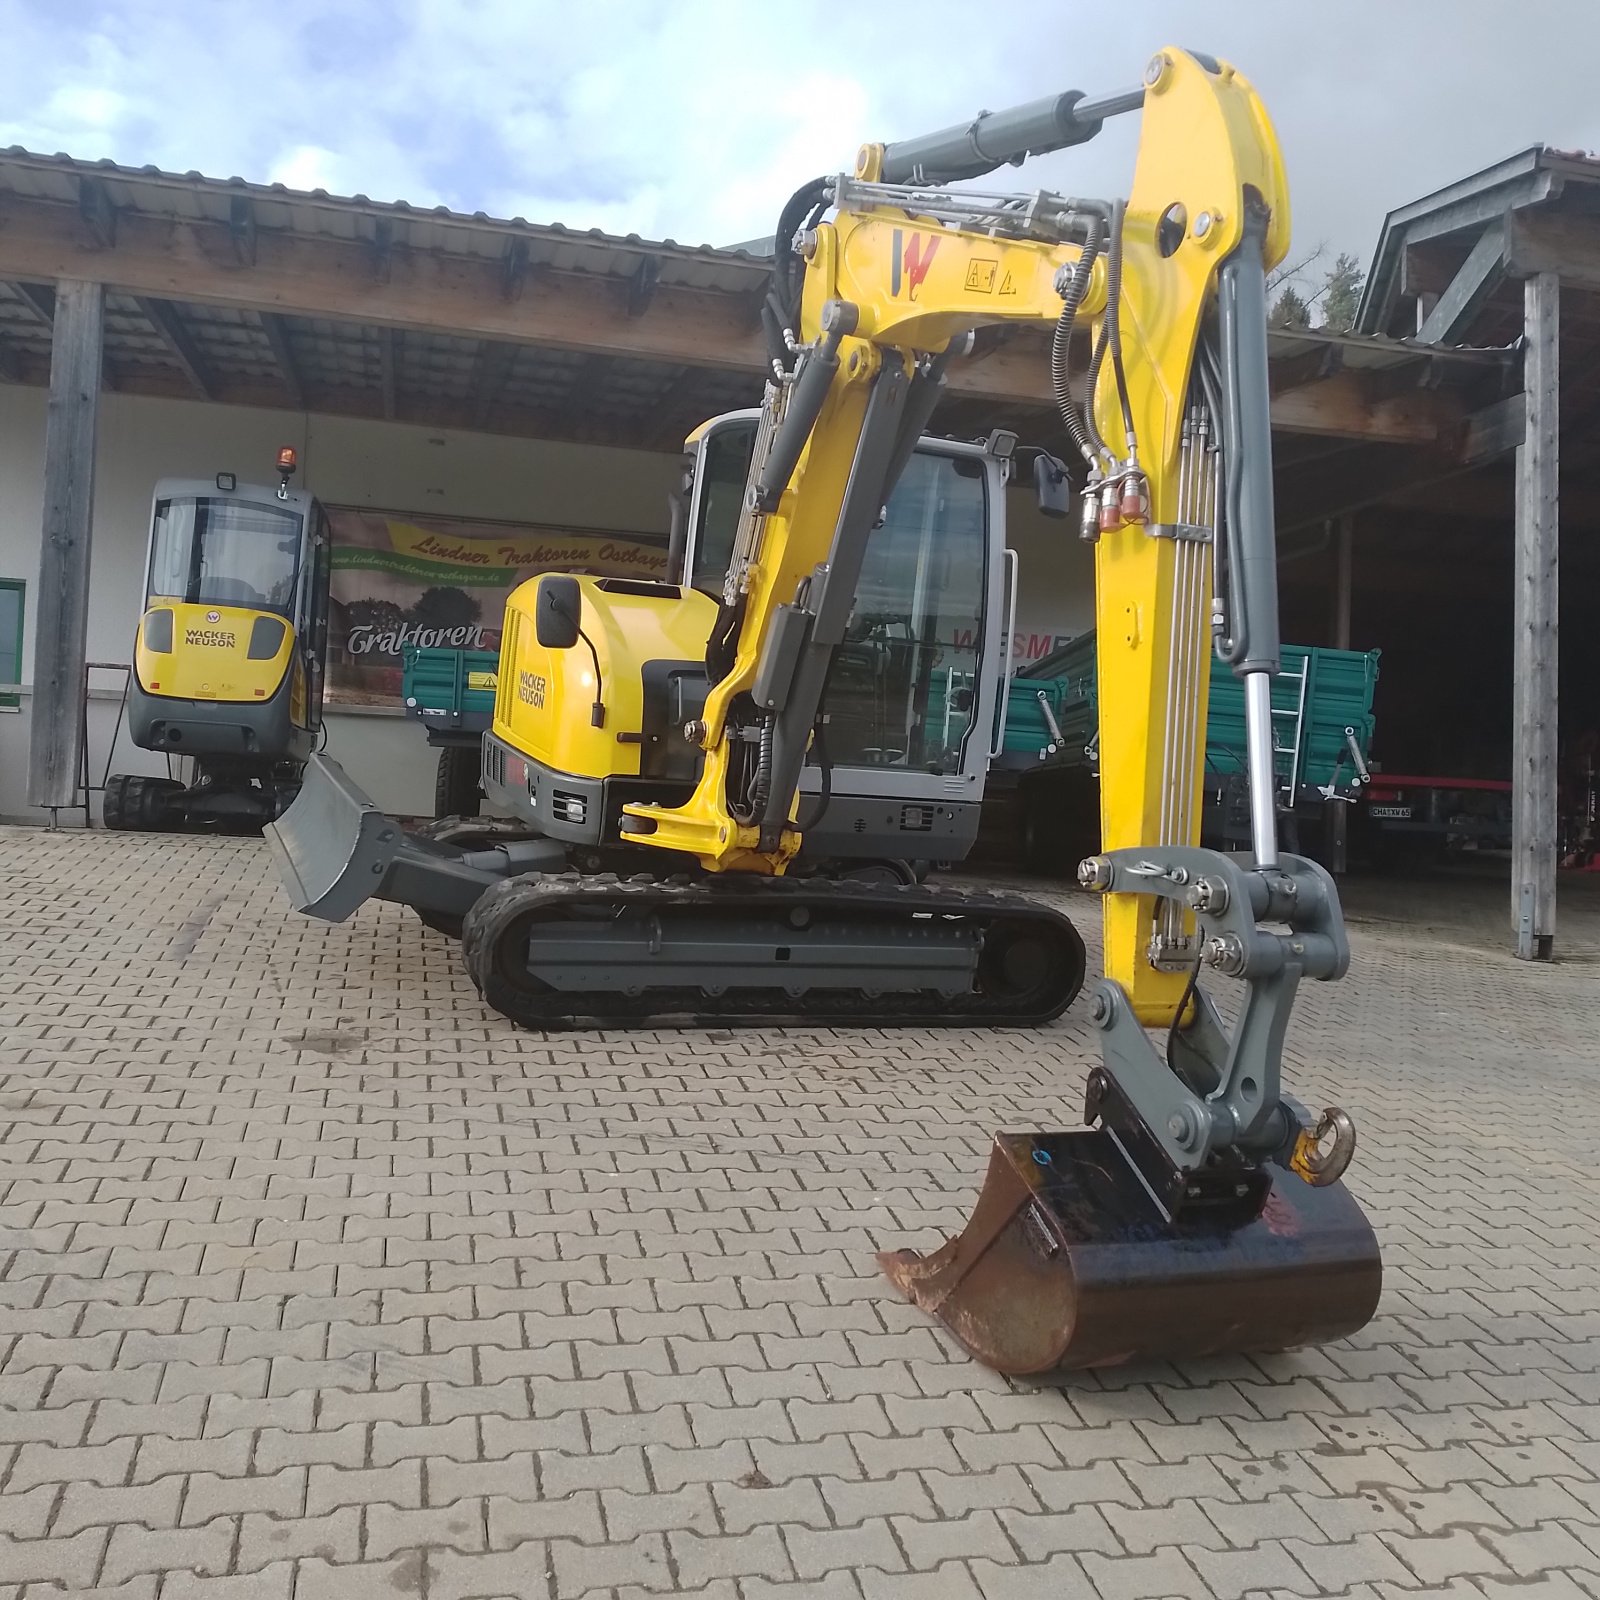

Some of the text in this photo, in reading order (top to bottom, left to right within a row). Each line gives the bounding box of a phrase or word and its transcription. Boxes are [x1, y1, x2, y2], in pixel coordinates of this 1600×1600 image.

[411, 536, 669, 568] Lindner Traktoren Ostbaye
[185, 629, 235, 640] WACKER
[185, 637, 235, 648] NEUSON
[347, 622, 487, 656] Traktoren
[520, 669, 546, 694] WACKER
[518, 685, 545, 710] NEUSON
